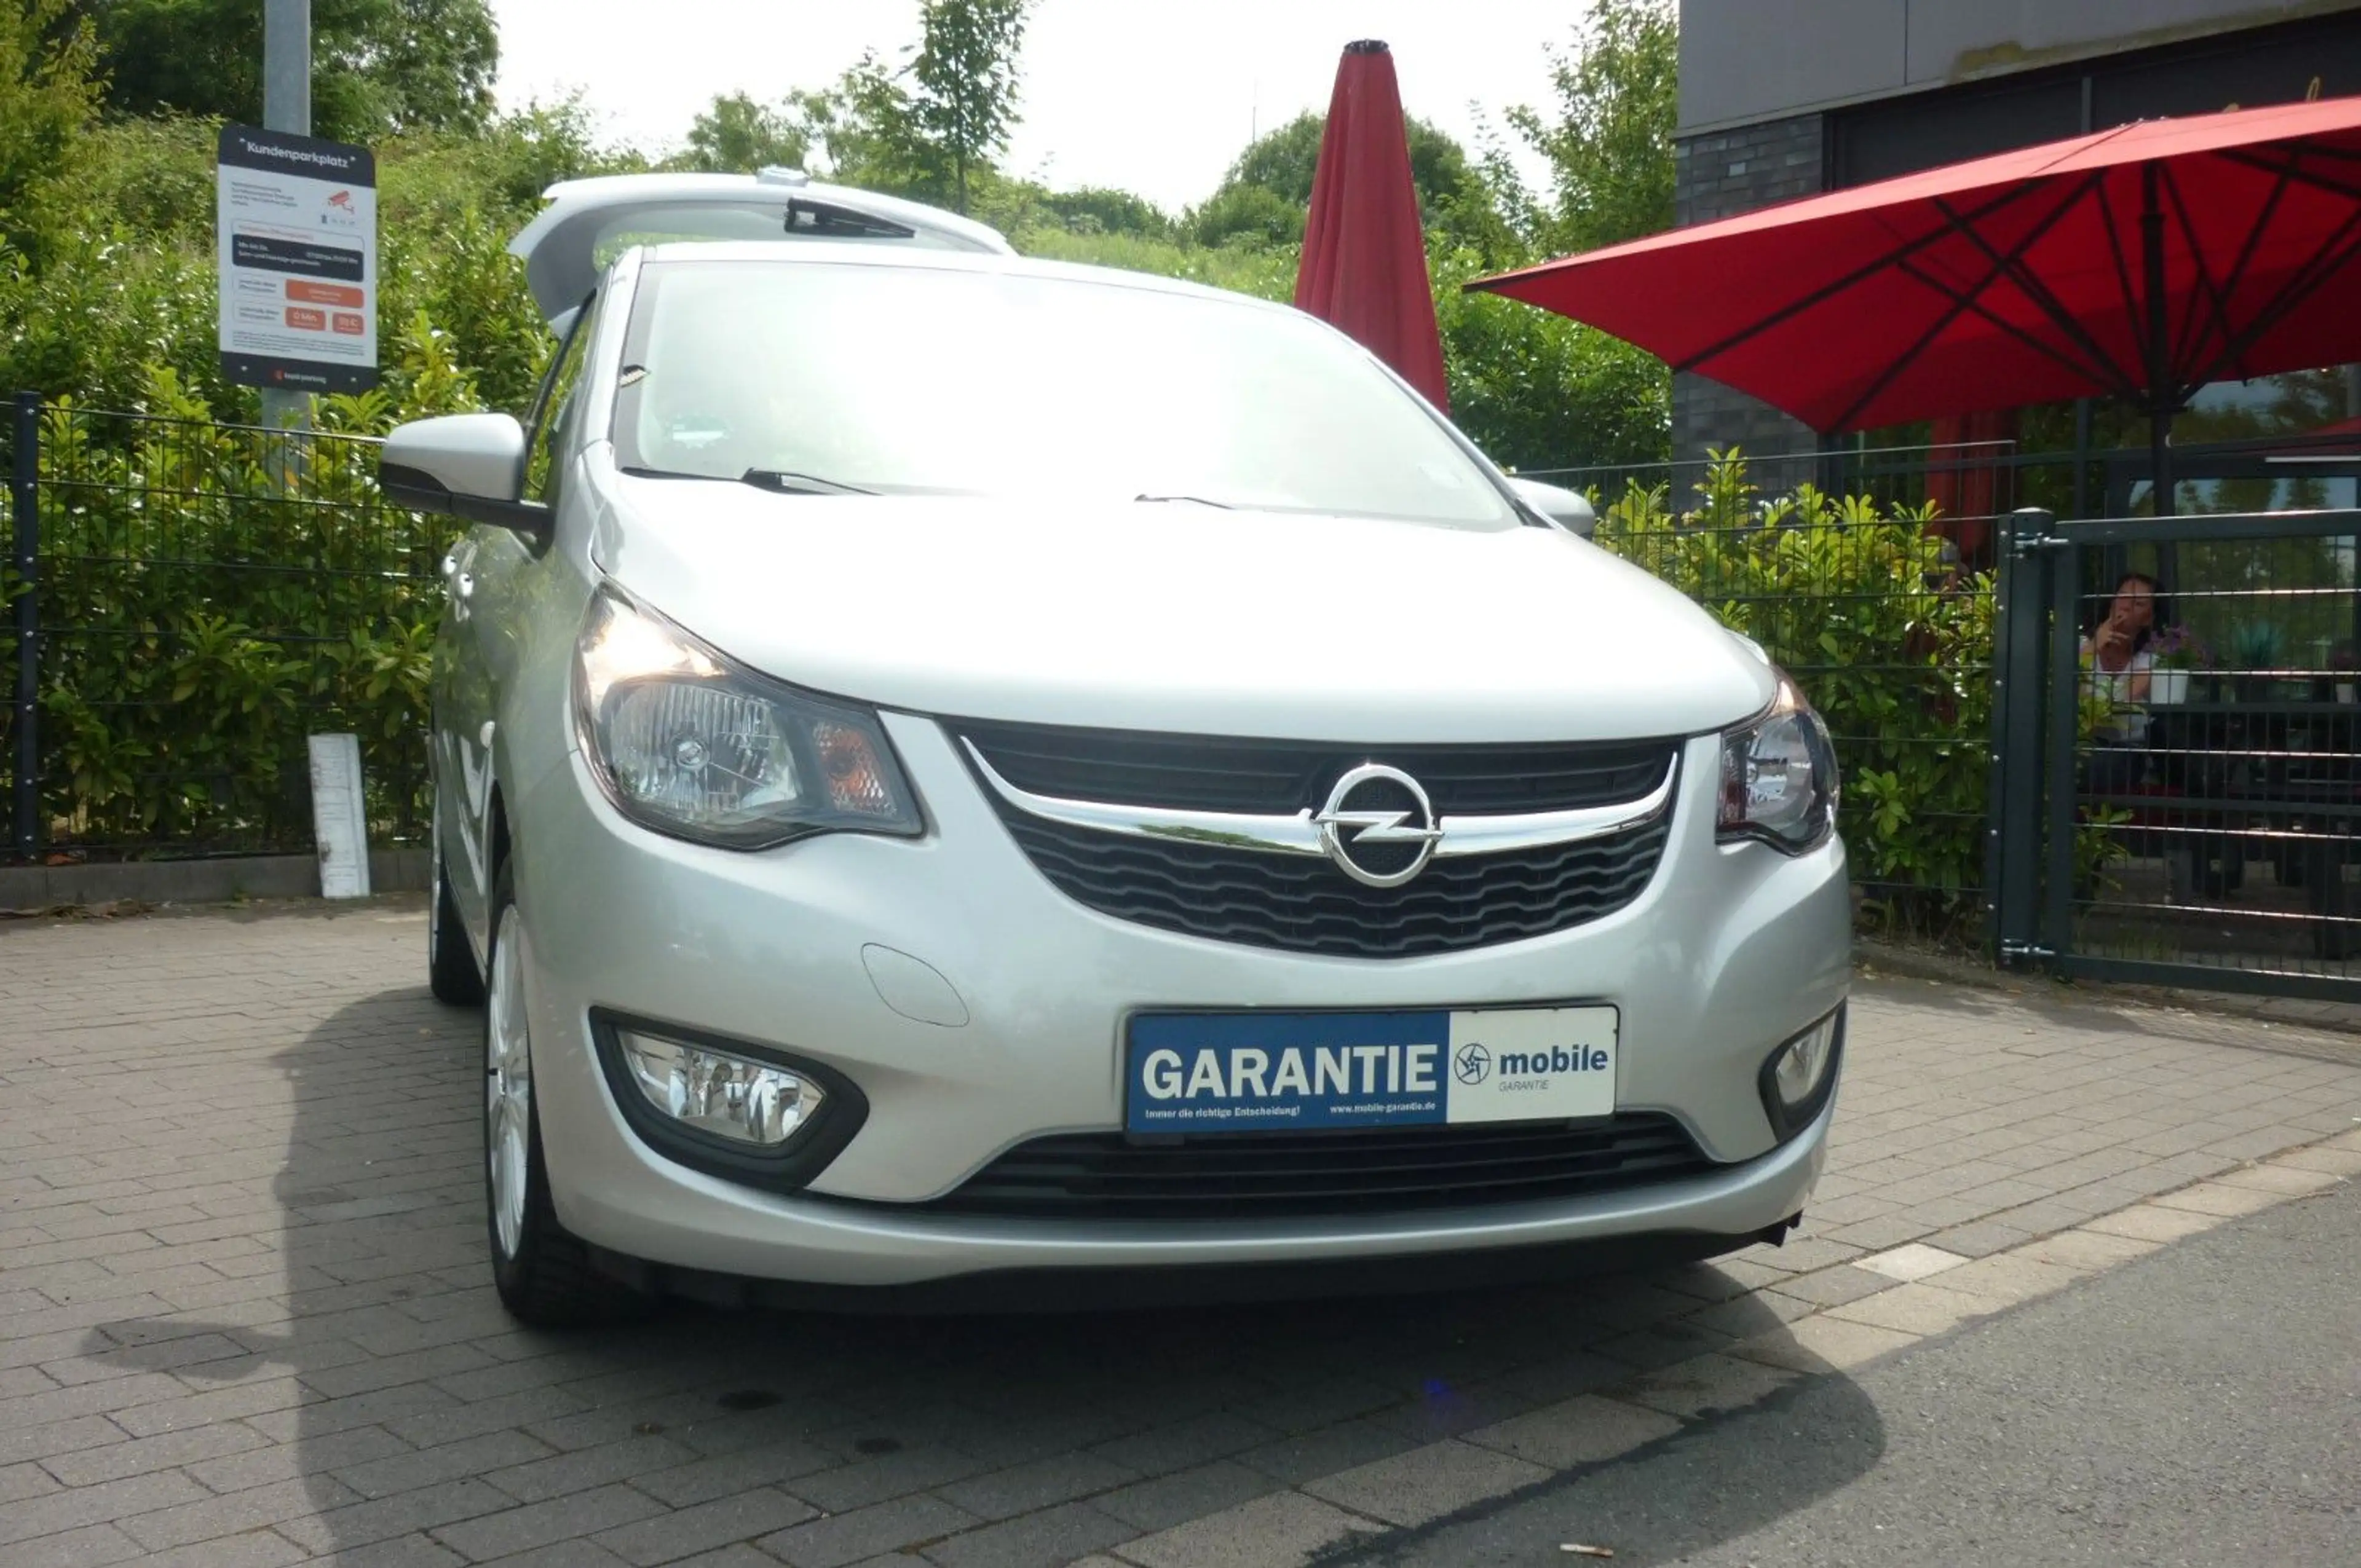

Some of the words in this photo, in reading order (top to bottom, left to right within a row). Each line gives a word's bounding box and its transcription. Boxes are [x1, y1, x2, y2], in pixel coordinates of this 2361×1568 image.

[246, 141, 349, 168] Kundenparkplatz
[1500, 1044, 1608, 1075] mobile
[1142, 1043, 1438, 1100] GARANTIE
[1498, 1080, 1550, 1092] GARANTIE
[1145, 1108, 1176, 1119] Immer
[1178, 1108, 1194, 1118] die
[1195, 1106, 1233, 1119] richtige
[1234, 1105, 1301, 1118] Entscheidung!
[1329, 1101, 1436, 1114] www.mobile-garantie.de
